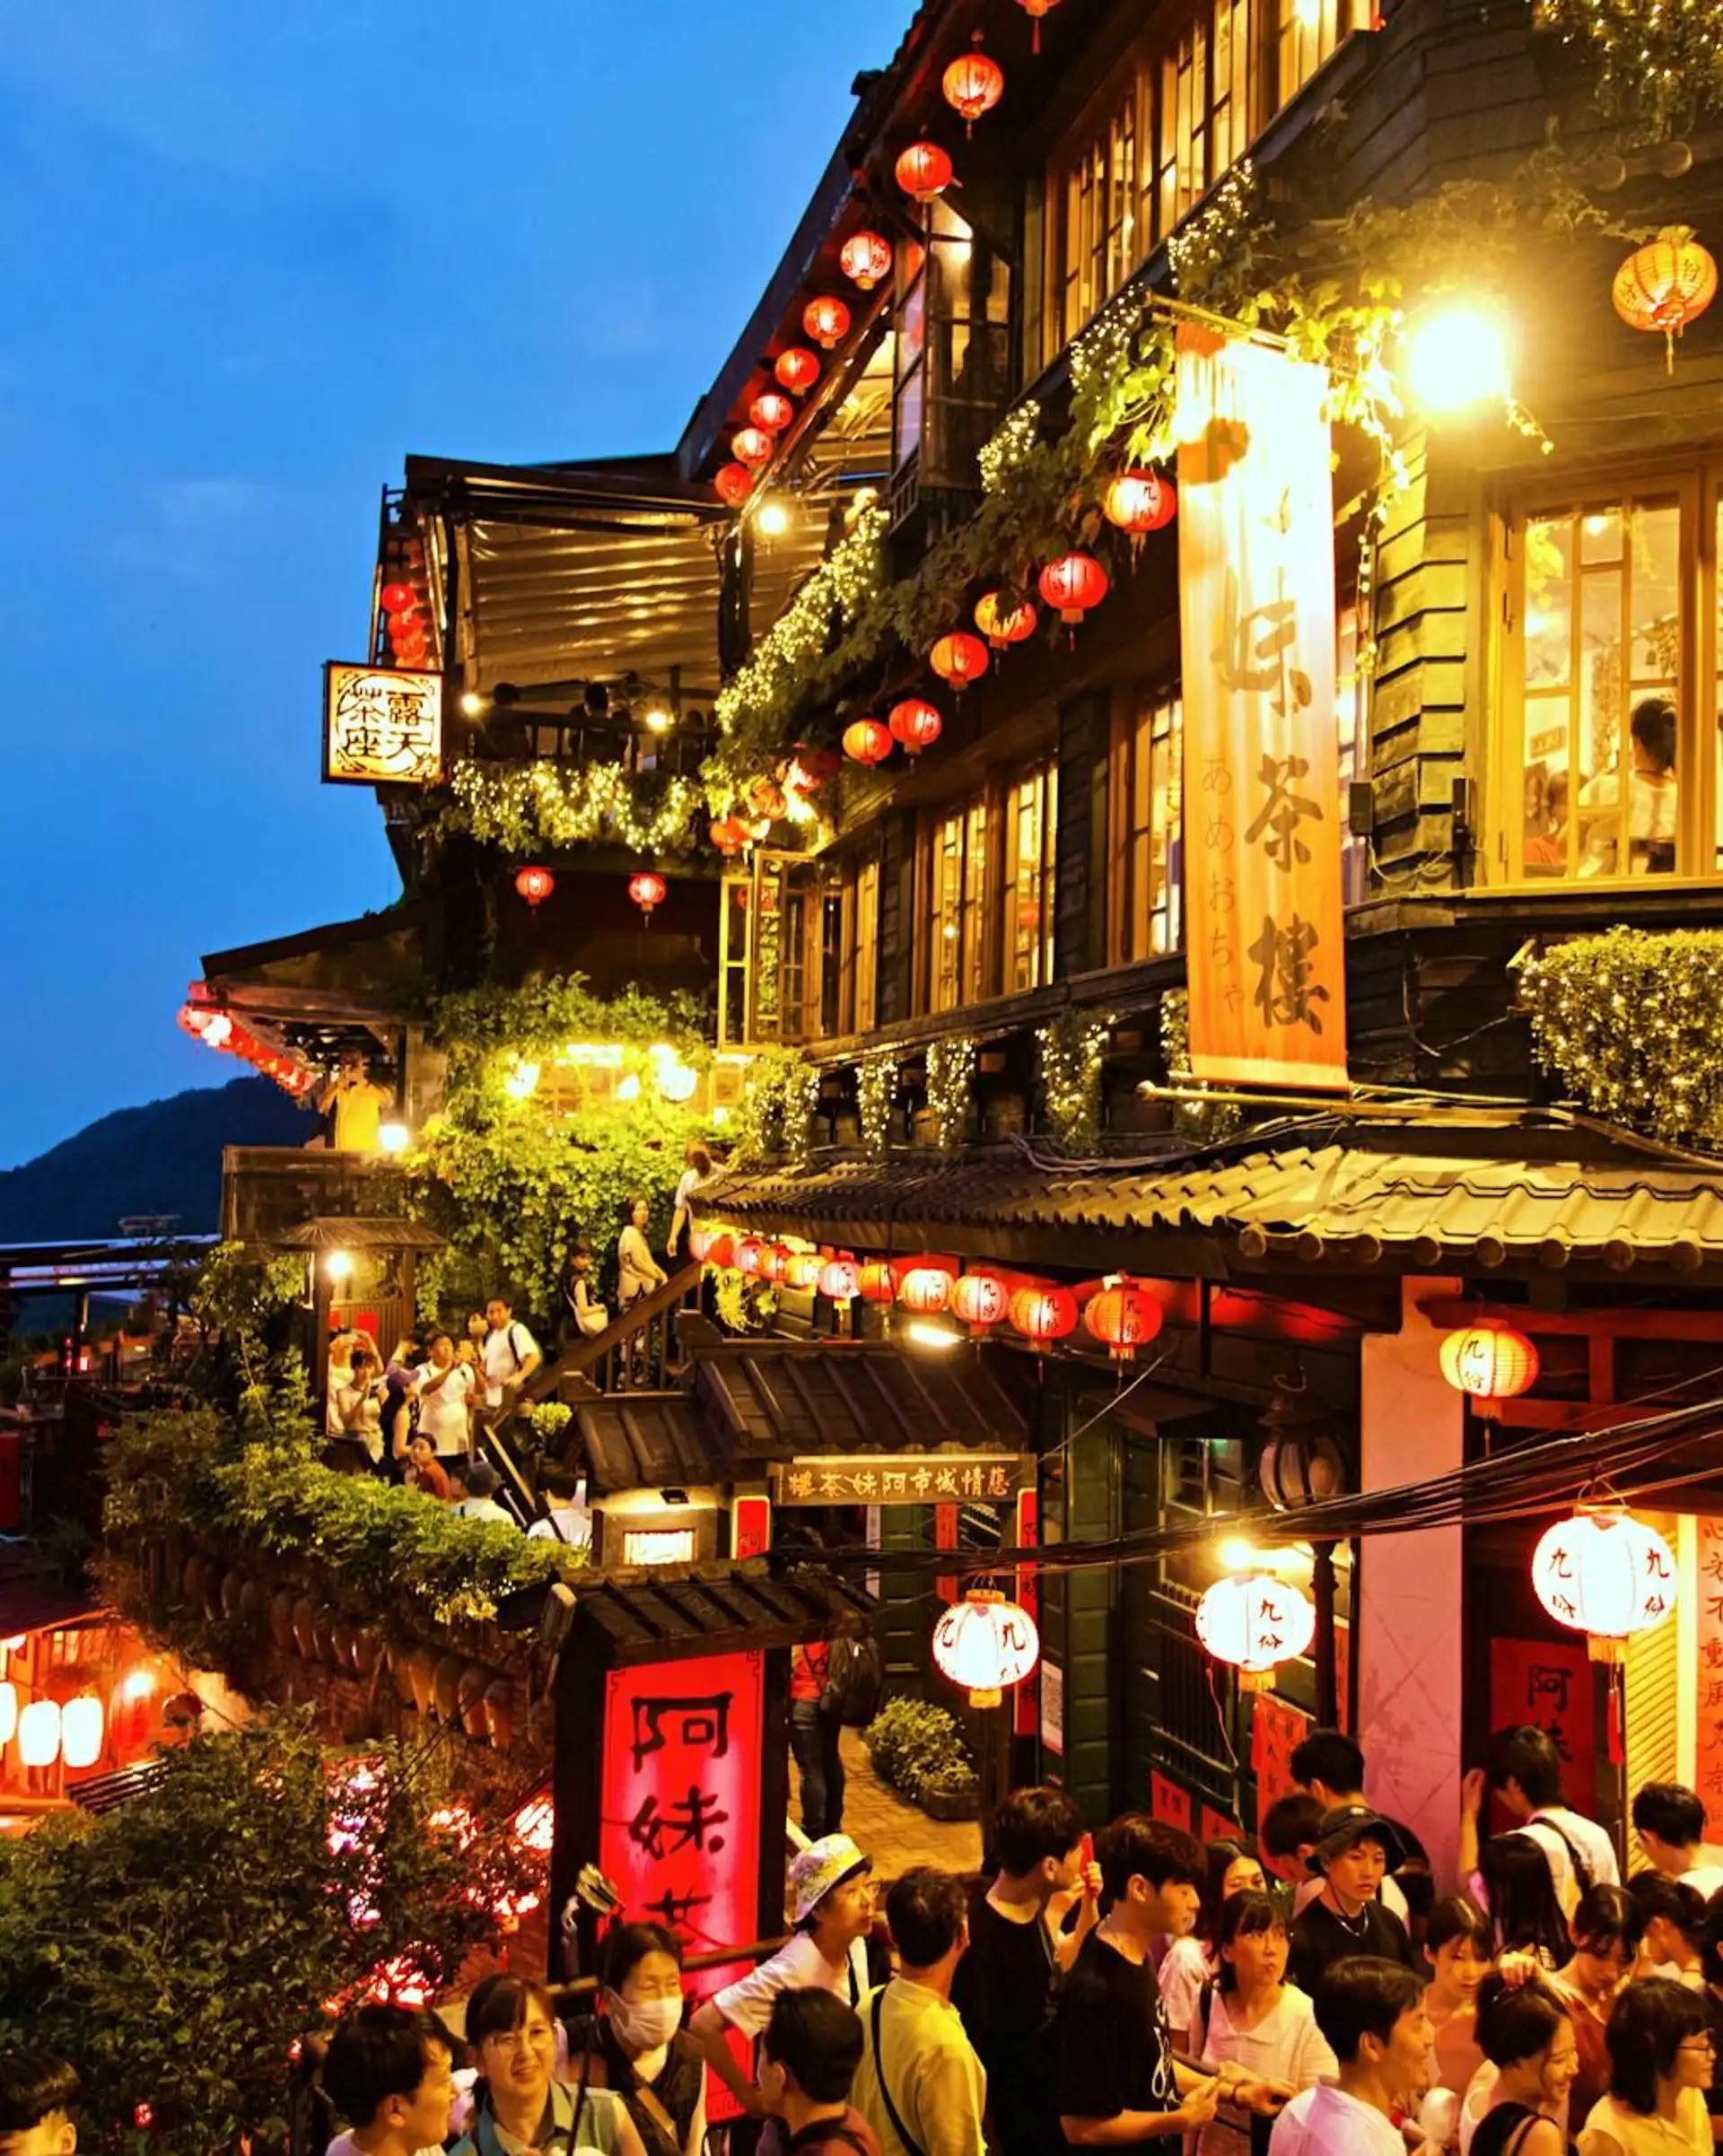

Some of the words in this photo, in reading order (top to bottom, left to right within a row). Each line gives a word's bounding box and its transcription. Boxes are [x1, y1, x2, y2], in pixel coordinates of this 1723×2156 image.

[1210, 483, 1332, 1035] 妹茶樓
[1643, 1547, 1672, 1619] 九份
[1258, 1598, 1284, 1650] 九份
